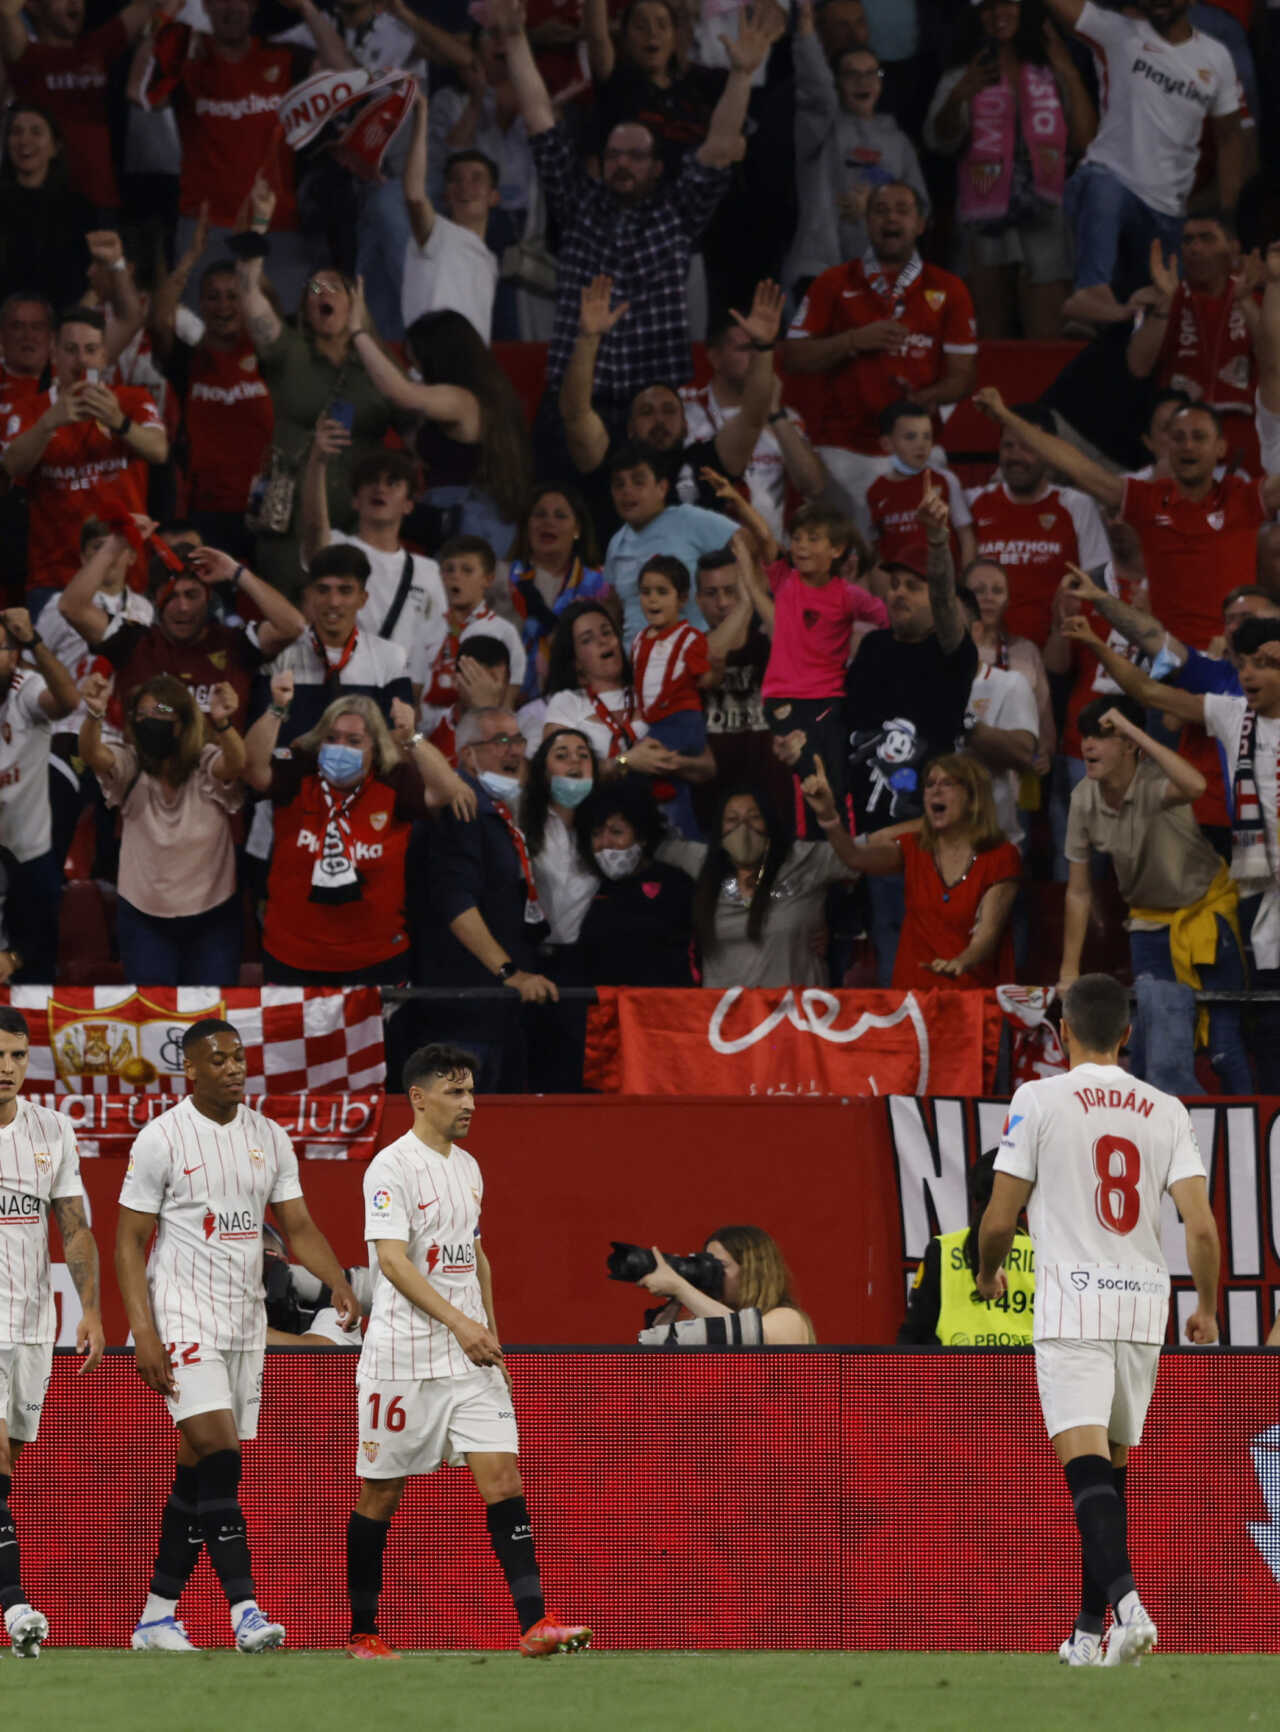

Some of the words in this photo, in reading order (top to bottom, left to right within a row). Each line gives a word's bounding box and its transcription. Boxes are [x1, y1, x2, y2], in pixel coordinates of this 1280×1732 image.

[1074, 1088, 1156, 1119] JORDÁN
[1091, 1133, 1143, 1238] 8
[218, 1210, 257, 1233] NAG
[368, 1392, 407, 1433] 16
